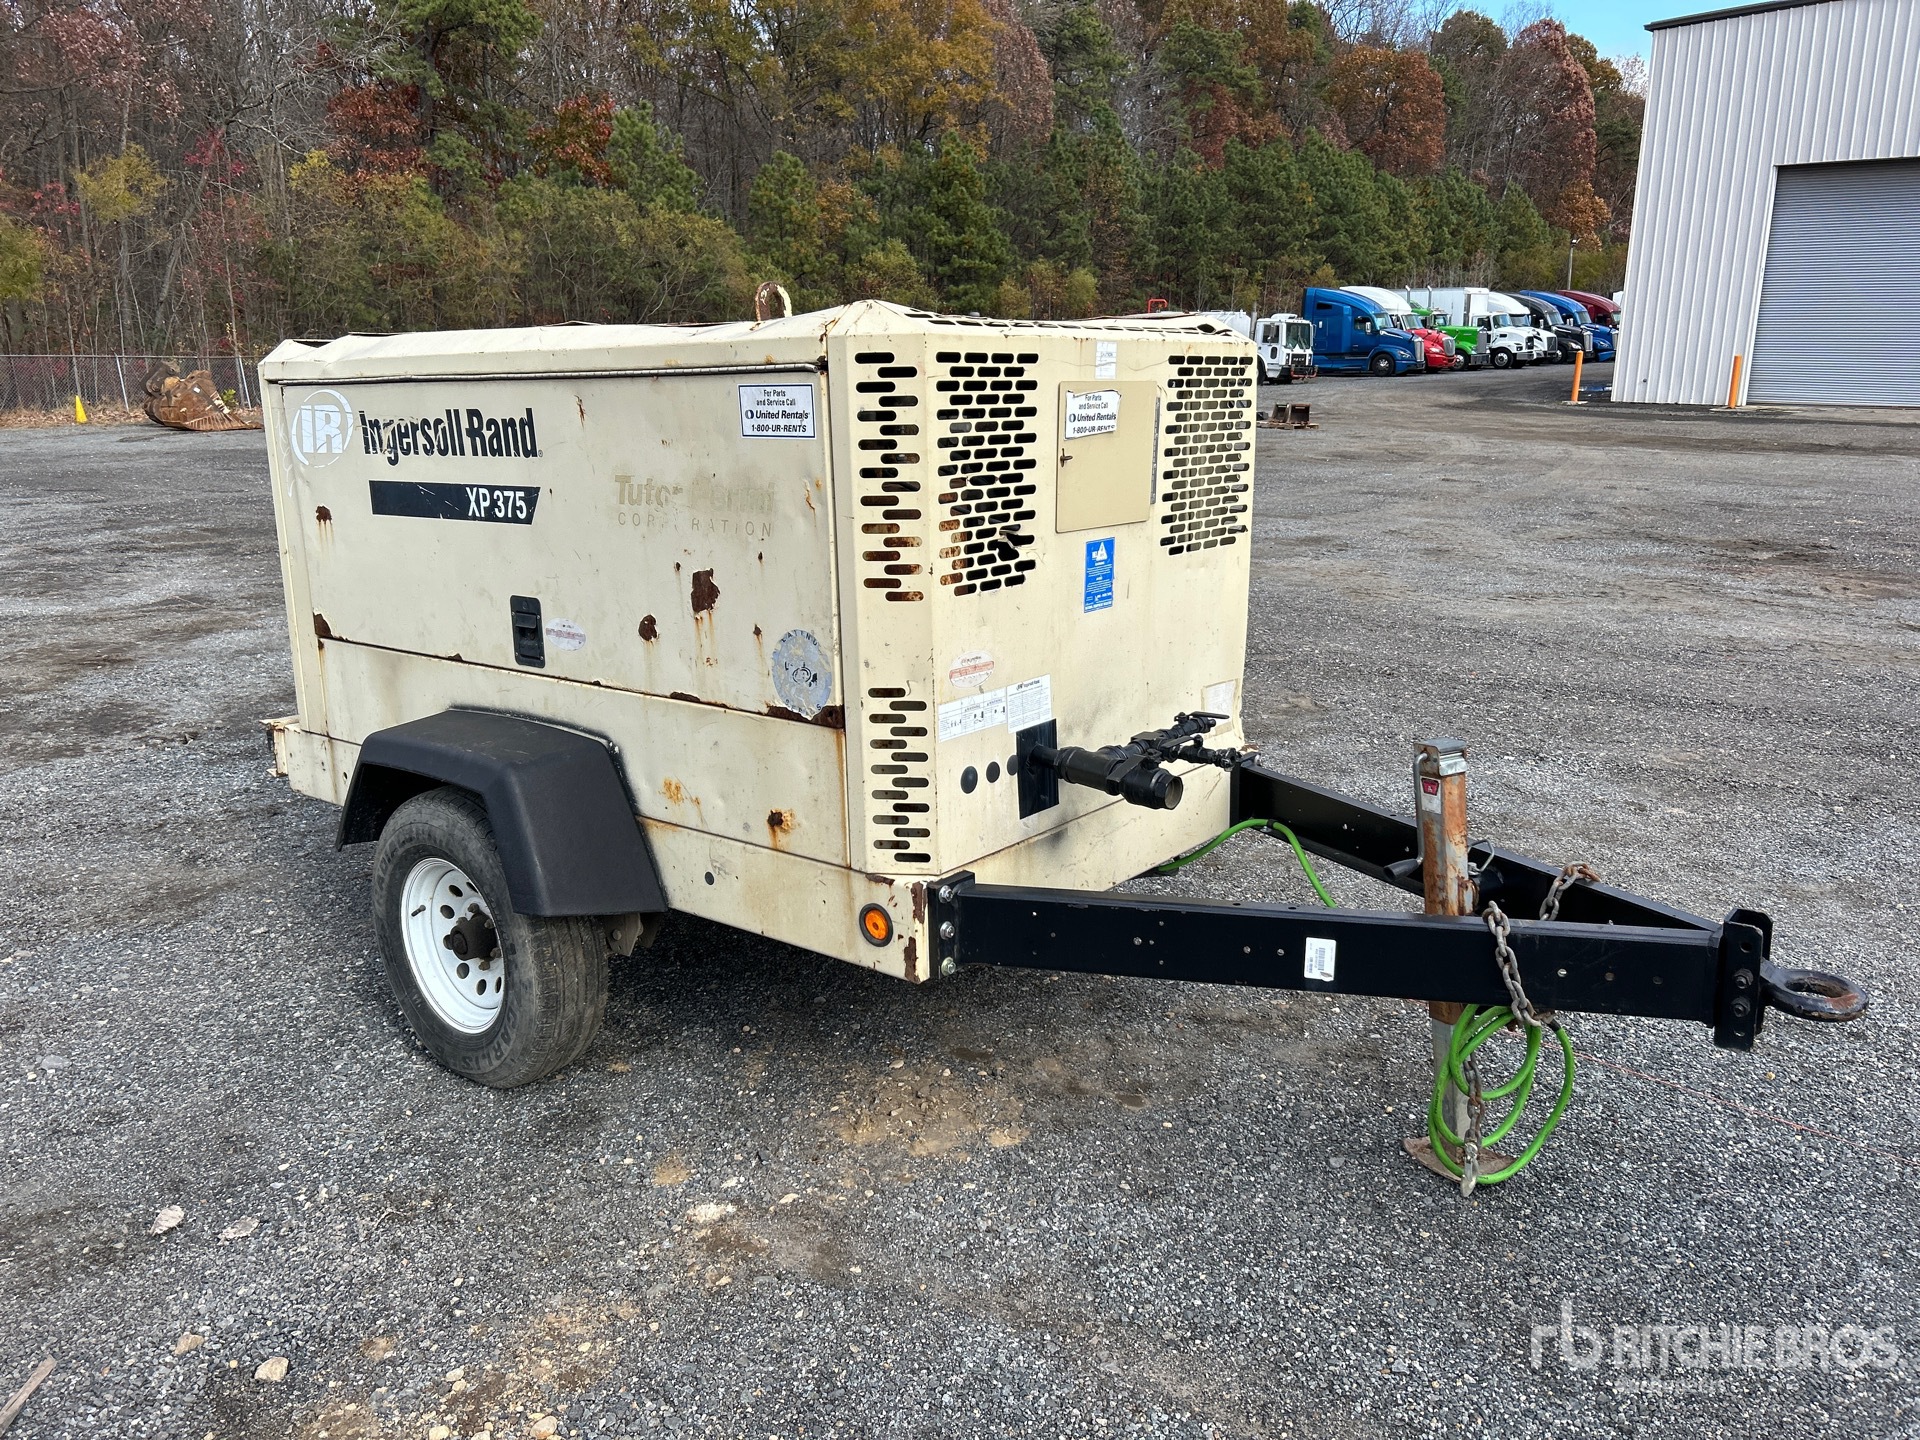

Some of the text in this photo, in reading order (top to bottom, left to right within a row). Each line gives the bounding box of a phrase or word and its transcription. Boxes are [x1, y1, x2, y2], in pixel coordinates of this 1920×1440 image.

[763, 389, 786, 397] For Parts
[756, 398, 796, 406] and Service Call
[1087, 402, 1100, 410] Service
[755, 409, 809, 419] United Rentals
[1077, 412, 1117, 422] United Rentals
[300, 404, 344, 454] IR
[751, 424, 807, 433] 1-800-UR-RENTS
[465, 486, 528, 520] XP 375
